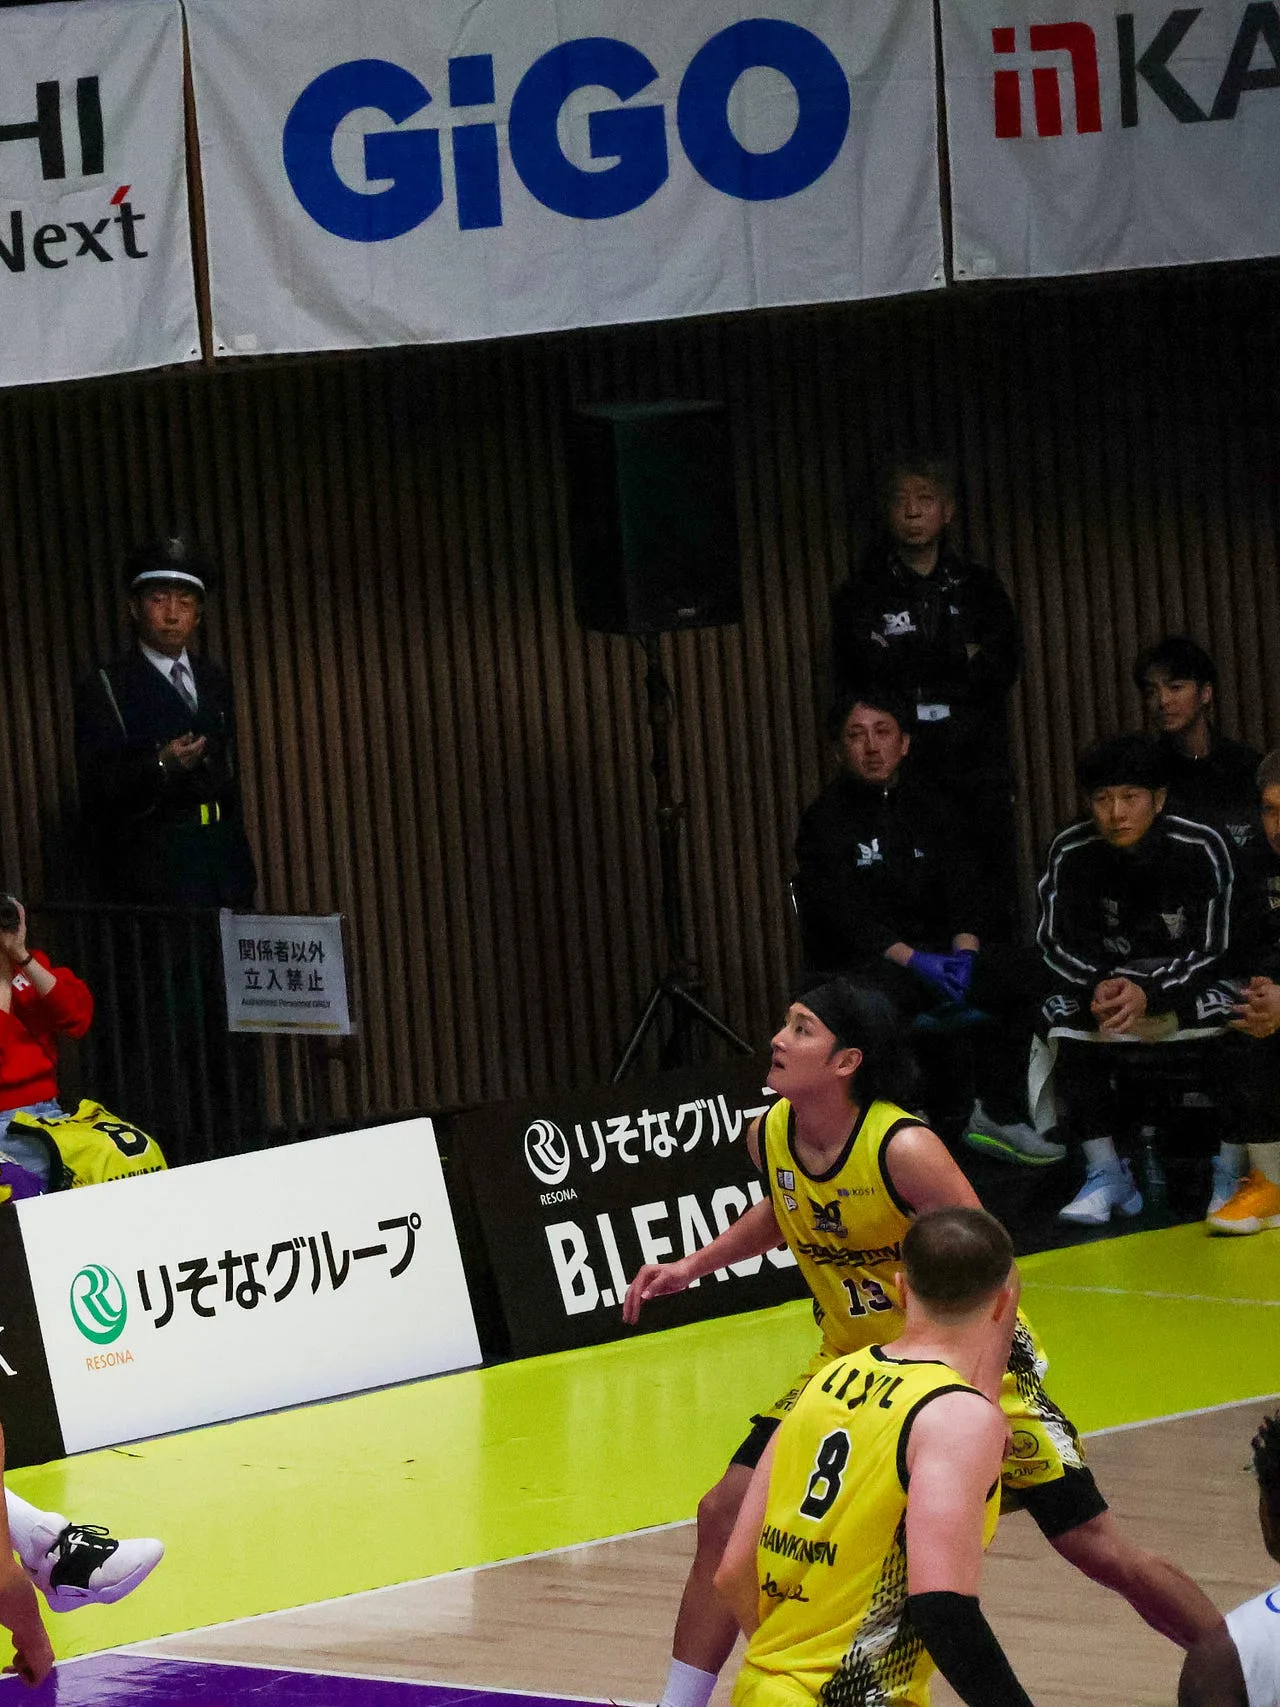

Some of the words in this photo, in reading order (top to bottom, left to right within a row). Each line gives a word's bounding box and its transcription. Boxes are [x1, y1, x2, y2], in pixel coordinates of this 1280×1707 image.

[283, 18, 851, 242] GiGO
[238, 939, 326, 963] 関係者以外
[244, 967, 325, 992] 立入禁止
[575, 1087, 778, 1172] りそなグルー
[540, 1187, 578, 1206] RESONA
[136, 1211, 422, 1329] りそなグループ
[544, 1179, 798, 1316] B.LEAG
[841, 1278, 894, 1318] 13
[85, 1348, 134, 1372] RESONA
[821, 1362, 904, 1410] LIXIL
[798, 1428, 852, 1523] 8
